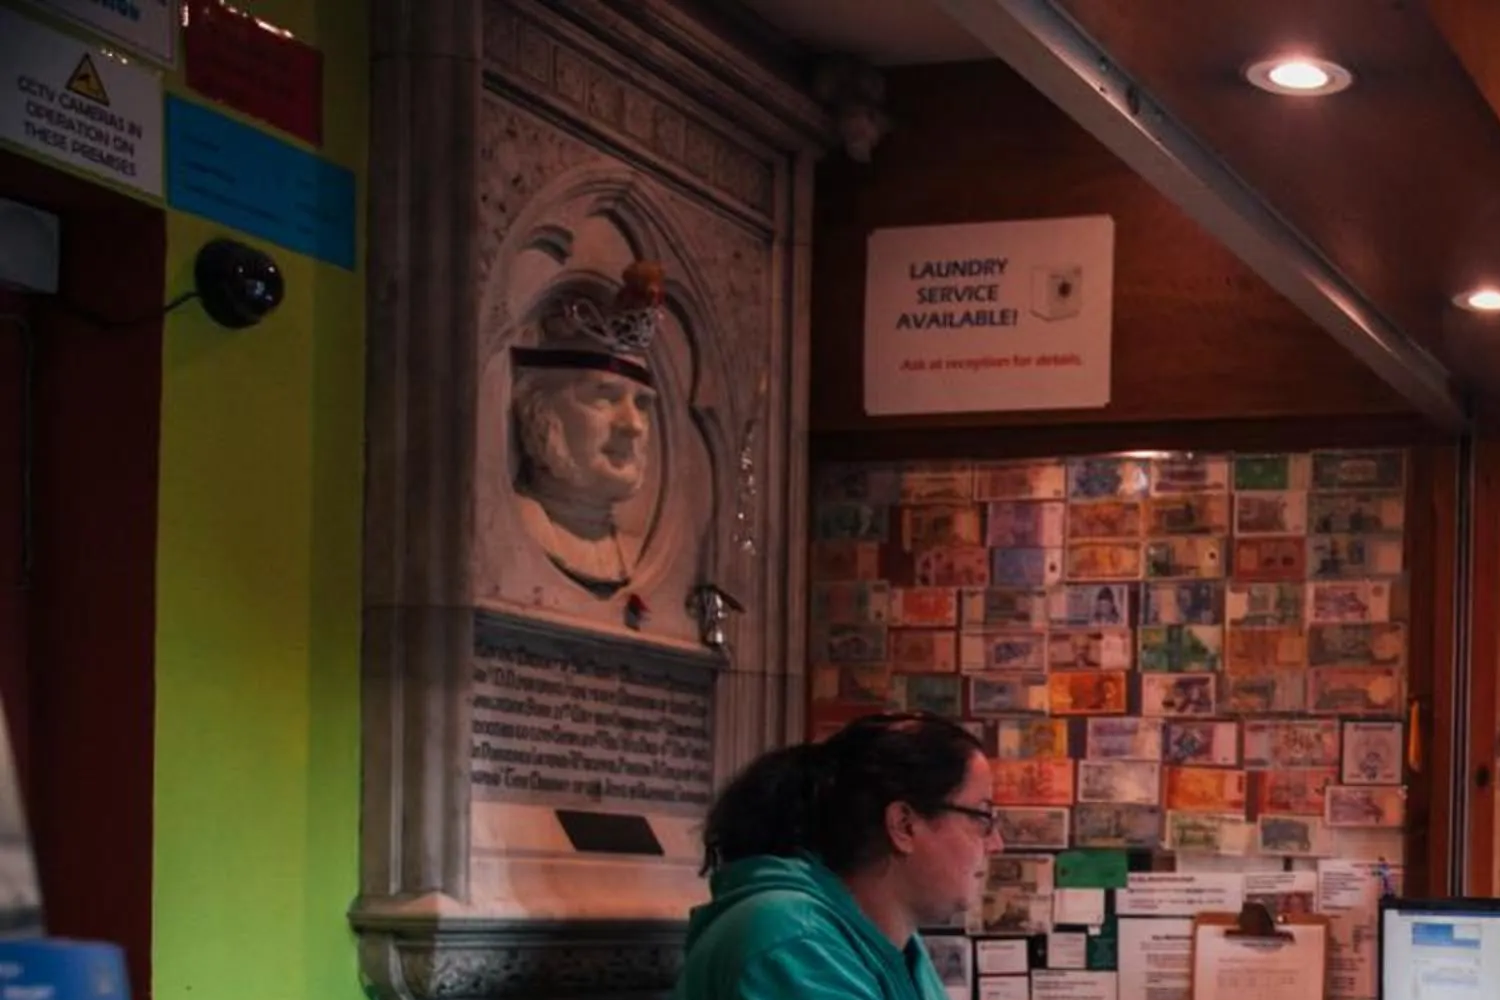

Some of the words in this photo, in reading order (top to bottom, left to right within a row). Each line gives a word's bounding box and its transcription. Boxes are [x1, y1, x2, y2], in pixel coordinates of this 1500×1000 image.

[17, 75, 56, 104] CCTV
[58, 91, 125, 131] CAMERAS
[127, 124, 142, 140] IN
[25, 101, 109, 147] OPERATION
[112, 133, 135, 157] ON
[23, 121, 68, 150] THESE
[71, 141, 137, 177] PREMISES
[909, 257, 1009, 280] LAUNDRY
[916, 284, 1000, 304] SERVICE
[896, 309, 1019, 330] AVAILABLE!
[945, 355, 1011, 373] reception
[1013, 354, 1033, 369] for
